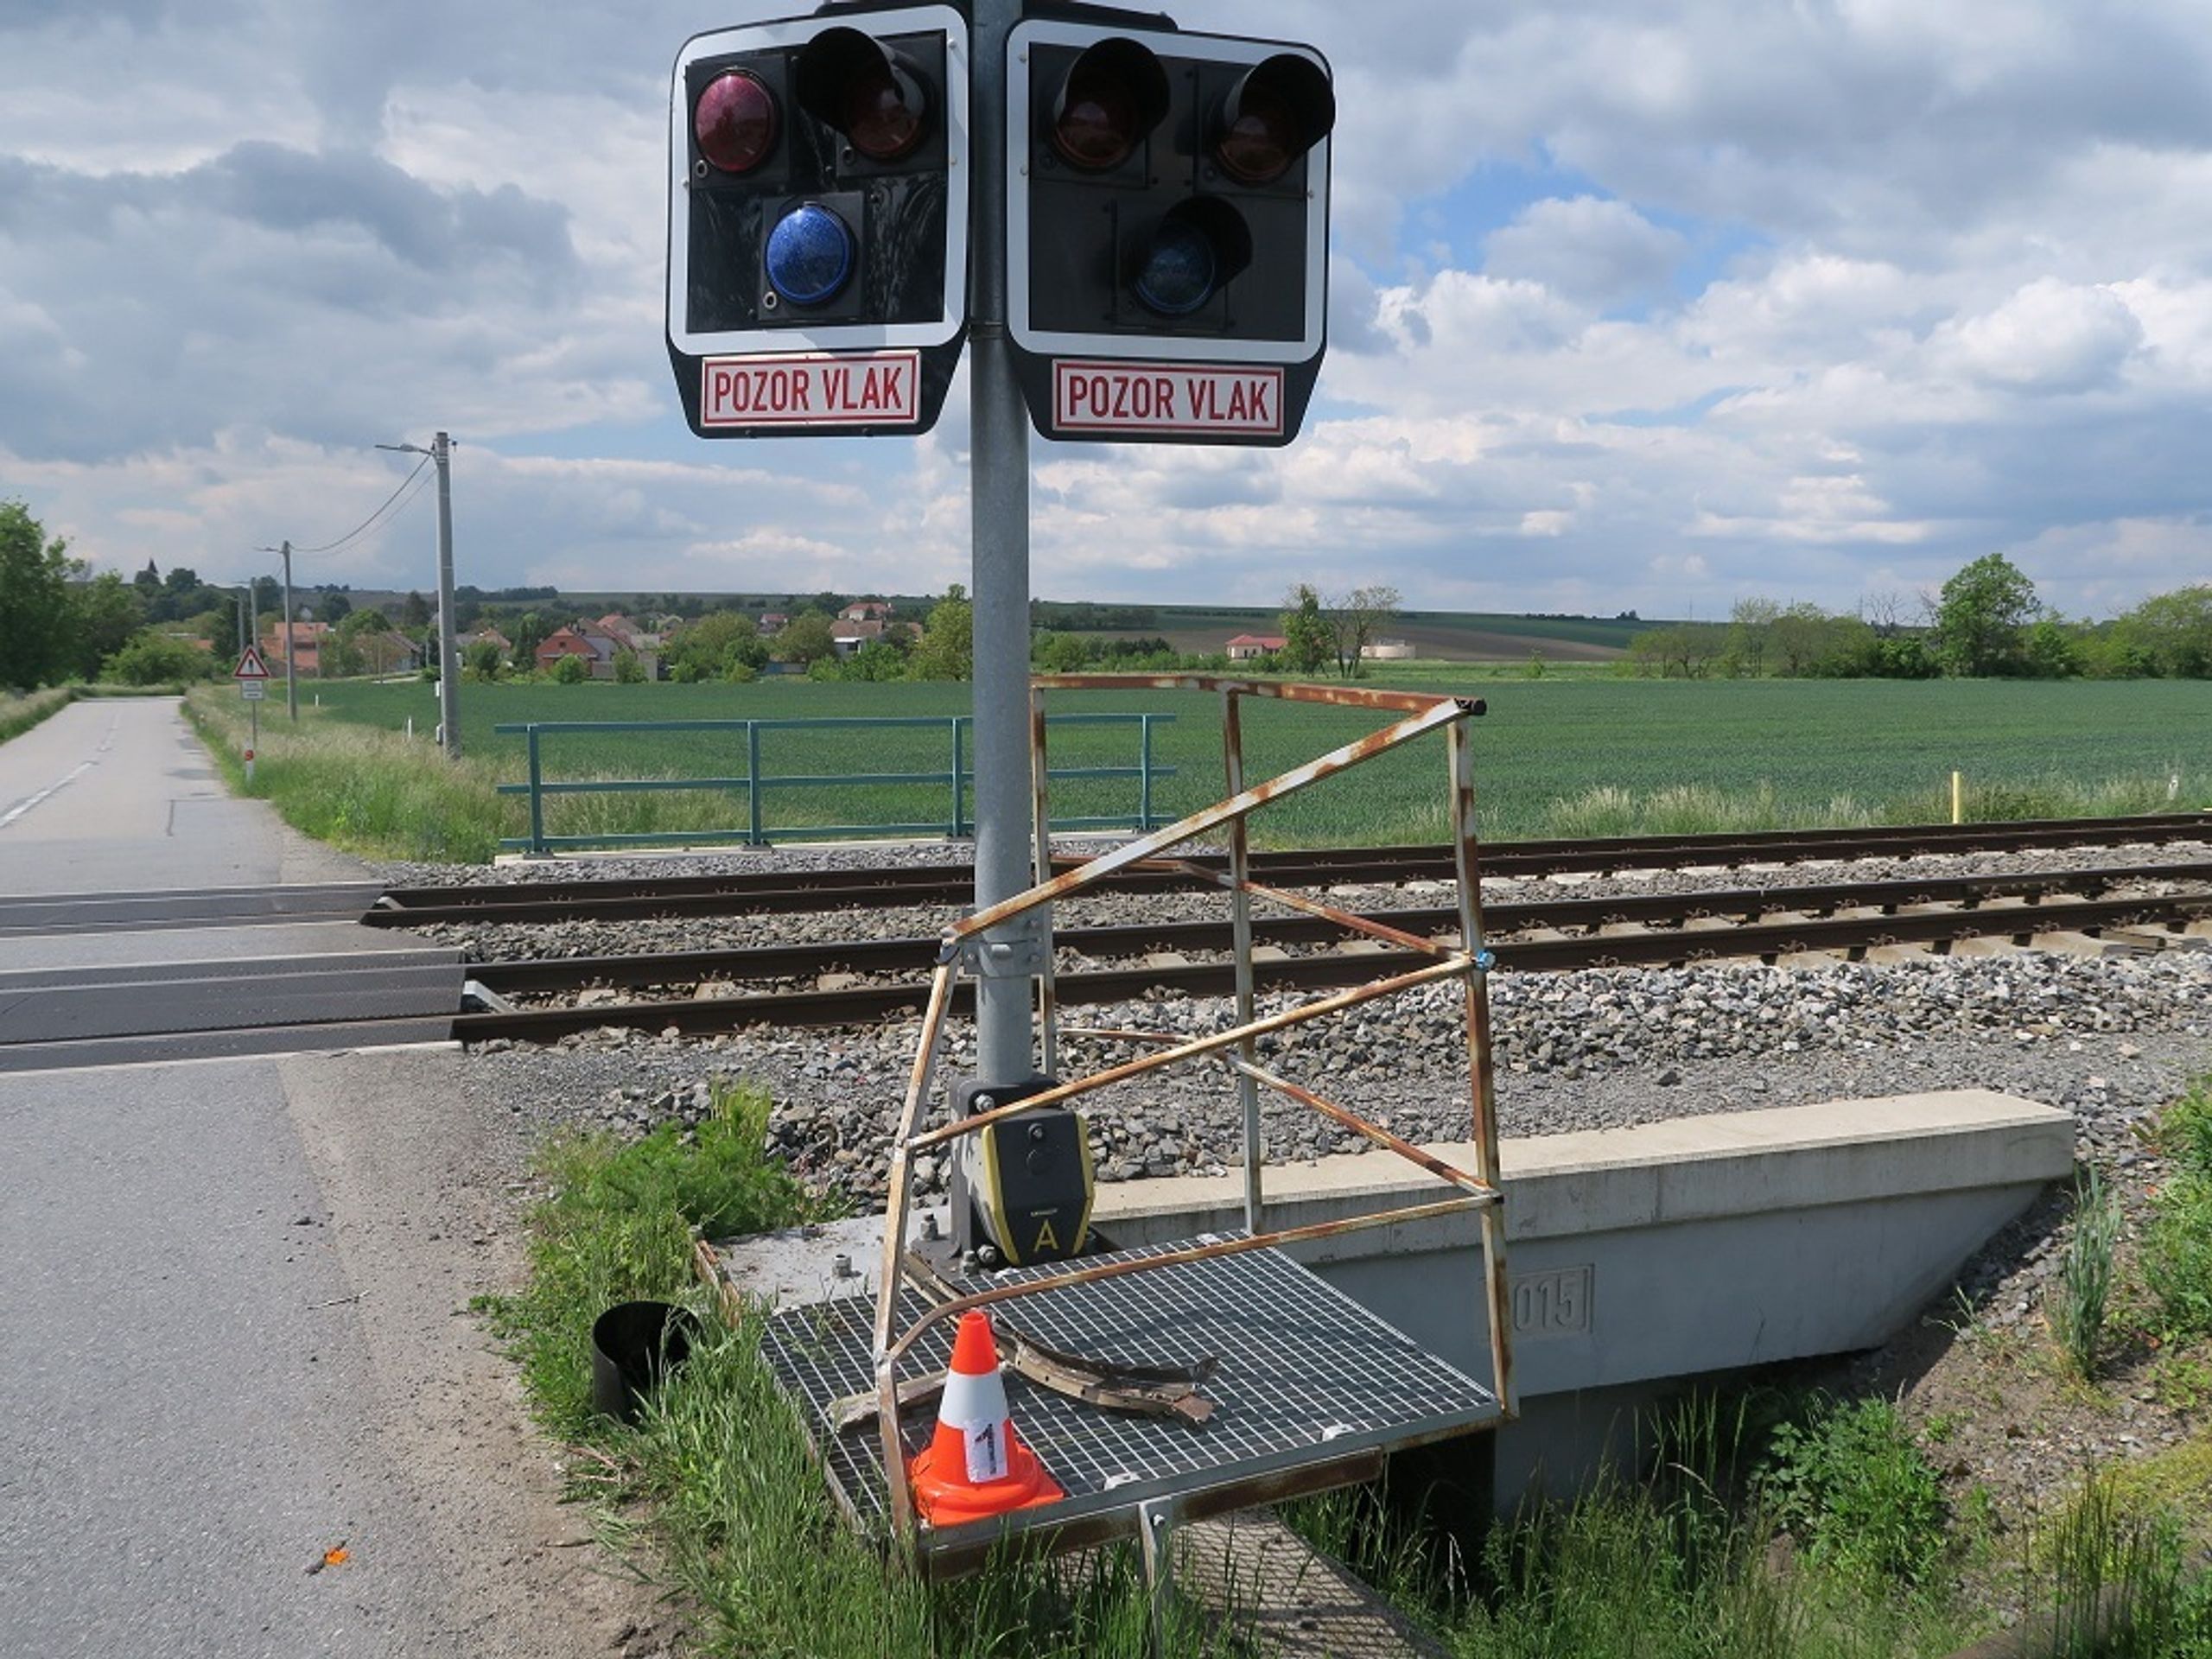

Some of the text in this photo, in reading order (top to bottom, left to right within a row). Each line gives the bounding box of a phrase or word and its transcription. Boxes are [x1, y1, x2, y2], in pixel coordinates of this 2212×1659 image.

[715, 366, 902, 413] POZOR VLAK
[1069, 375, 1268, 423] POZOR VLAK
[1033, 1218, 1059, 1252] A
[1514, 1274, 1573, 1332] 015
[975, 1423, 997, 1475] 1
